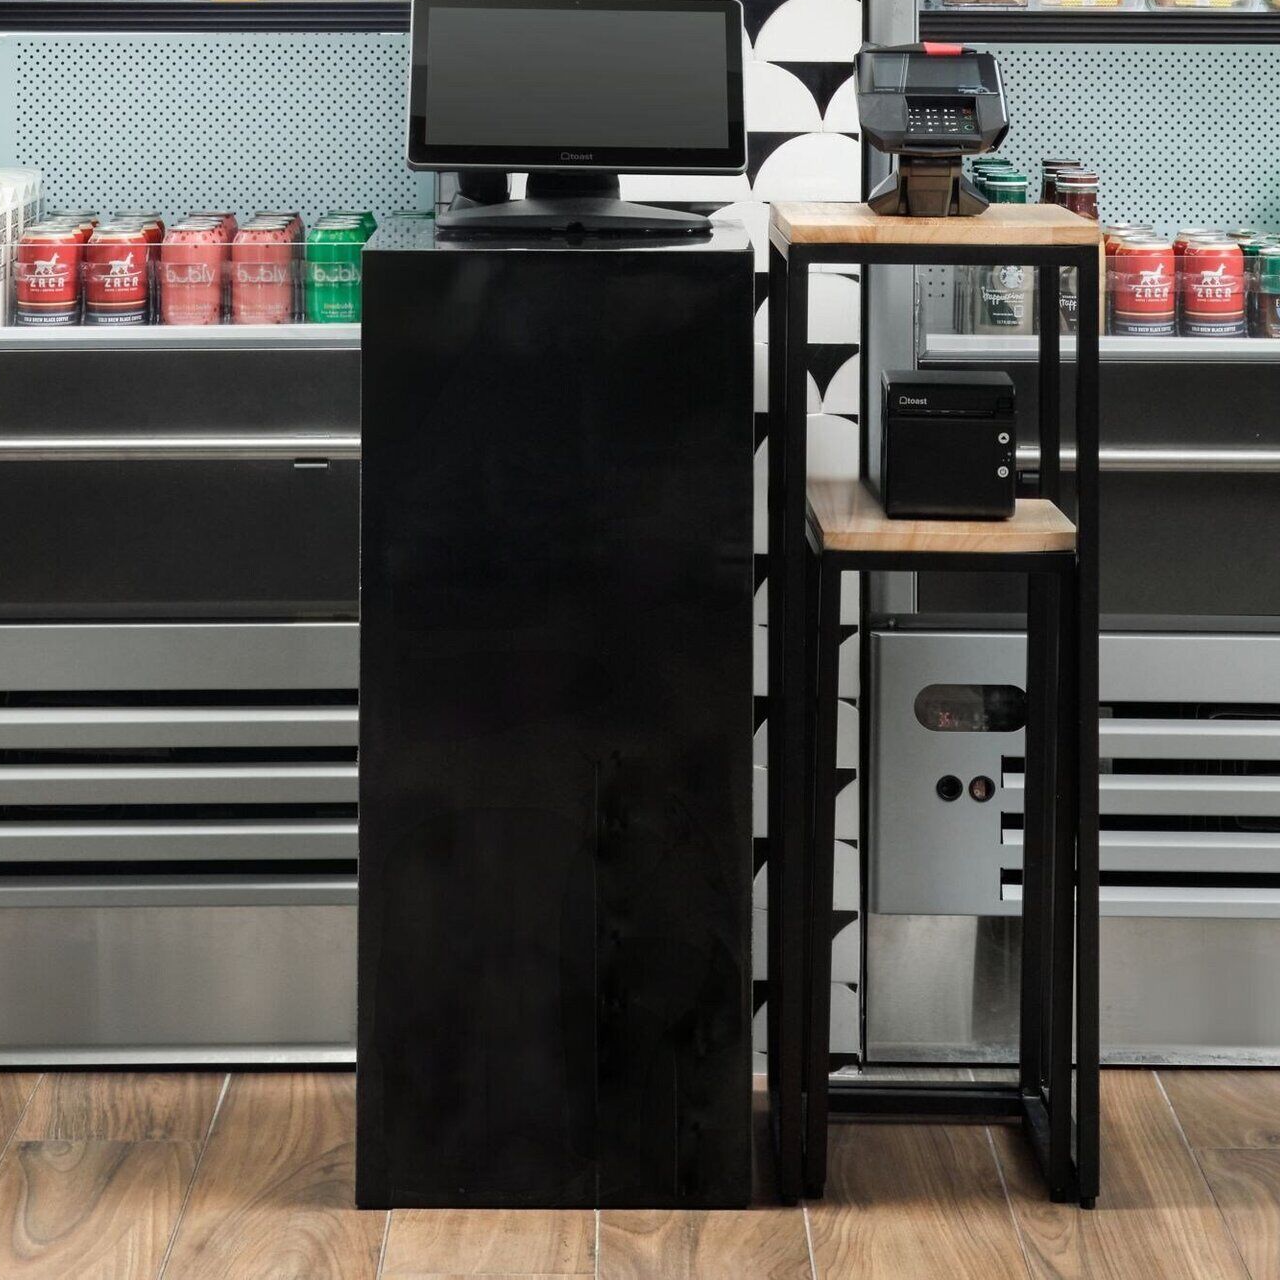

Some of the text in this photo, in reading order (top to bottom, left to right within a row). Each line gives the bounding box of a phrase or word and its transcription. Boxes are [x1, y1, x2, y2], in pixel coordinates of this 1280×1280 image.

[570, 153, 593, 161] toast
[166, 264, 215, 286] bubly
[907, 396, 928, 406] toast
